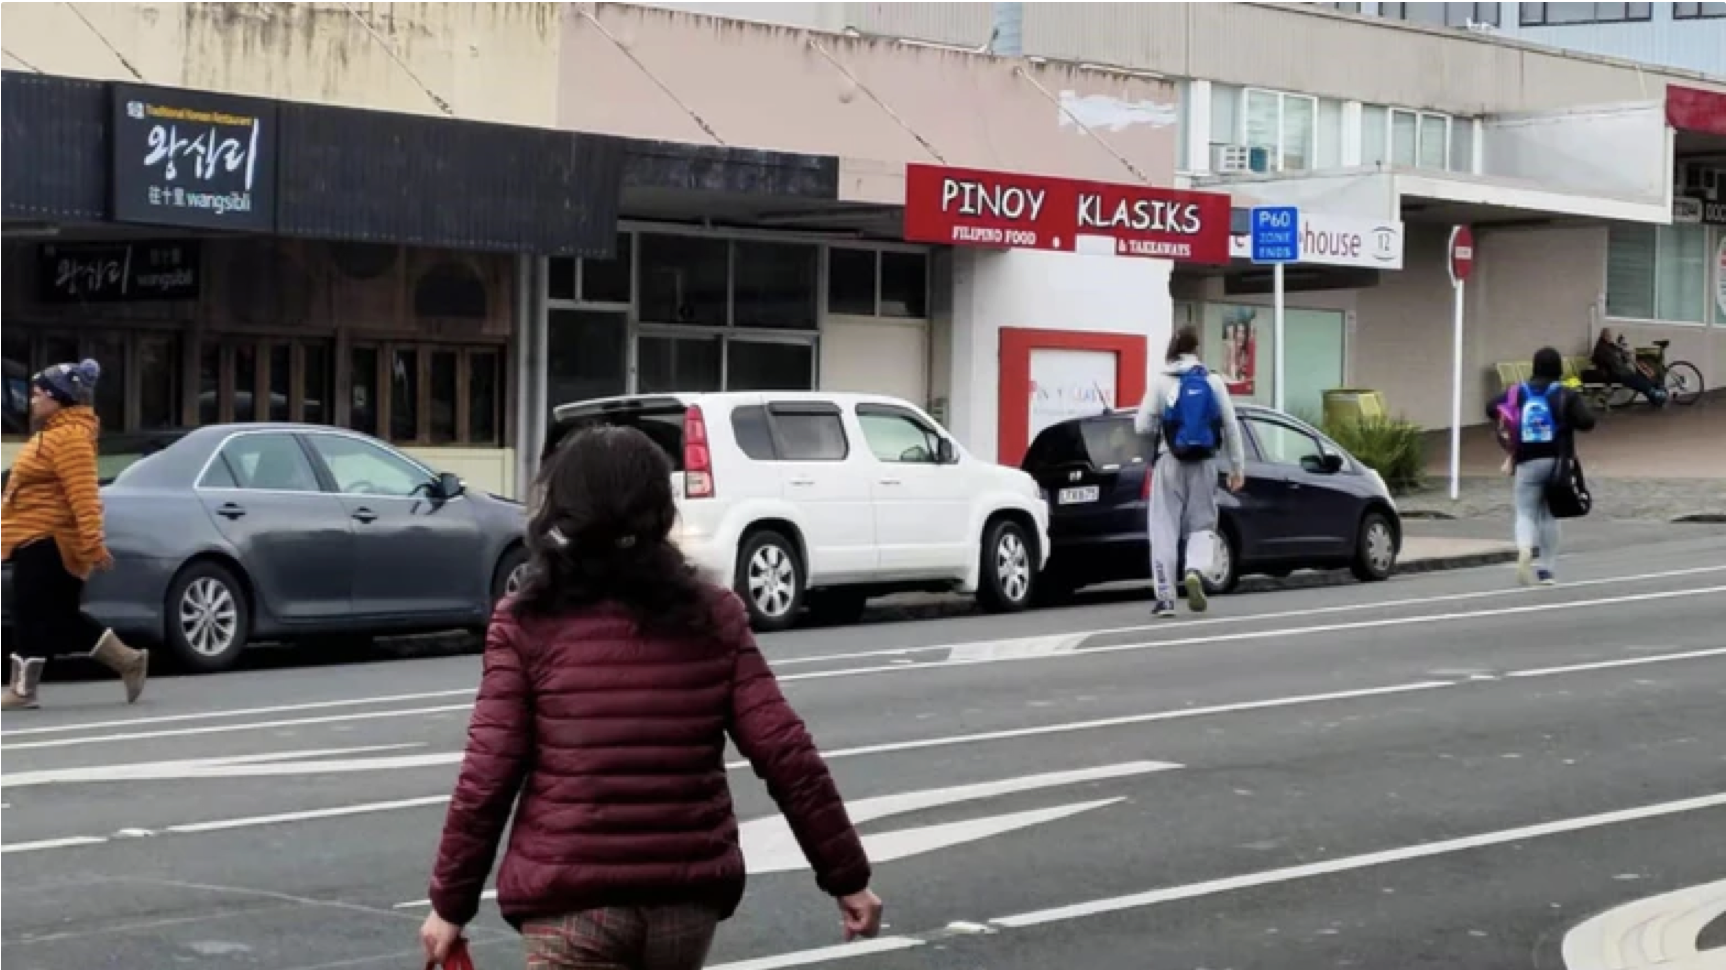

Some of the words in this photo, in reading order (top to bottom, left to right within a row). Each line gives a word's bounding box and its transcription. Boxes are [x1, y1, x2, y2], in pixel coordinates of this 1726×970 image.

[186, 190, 251, 214] wangsibli
[941, 178, 1046, 221] PINOY
[1077, 192, 1201, 234] KLASIKS
[1258, 210, 1291, 228] P60
[1004, 229, 1037, 246] FOOD
[1128, 239, 1192, 256] TAKEAWAYS
